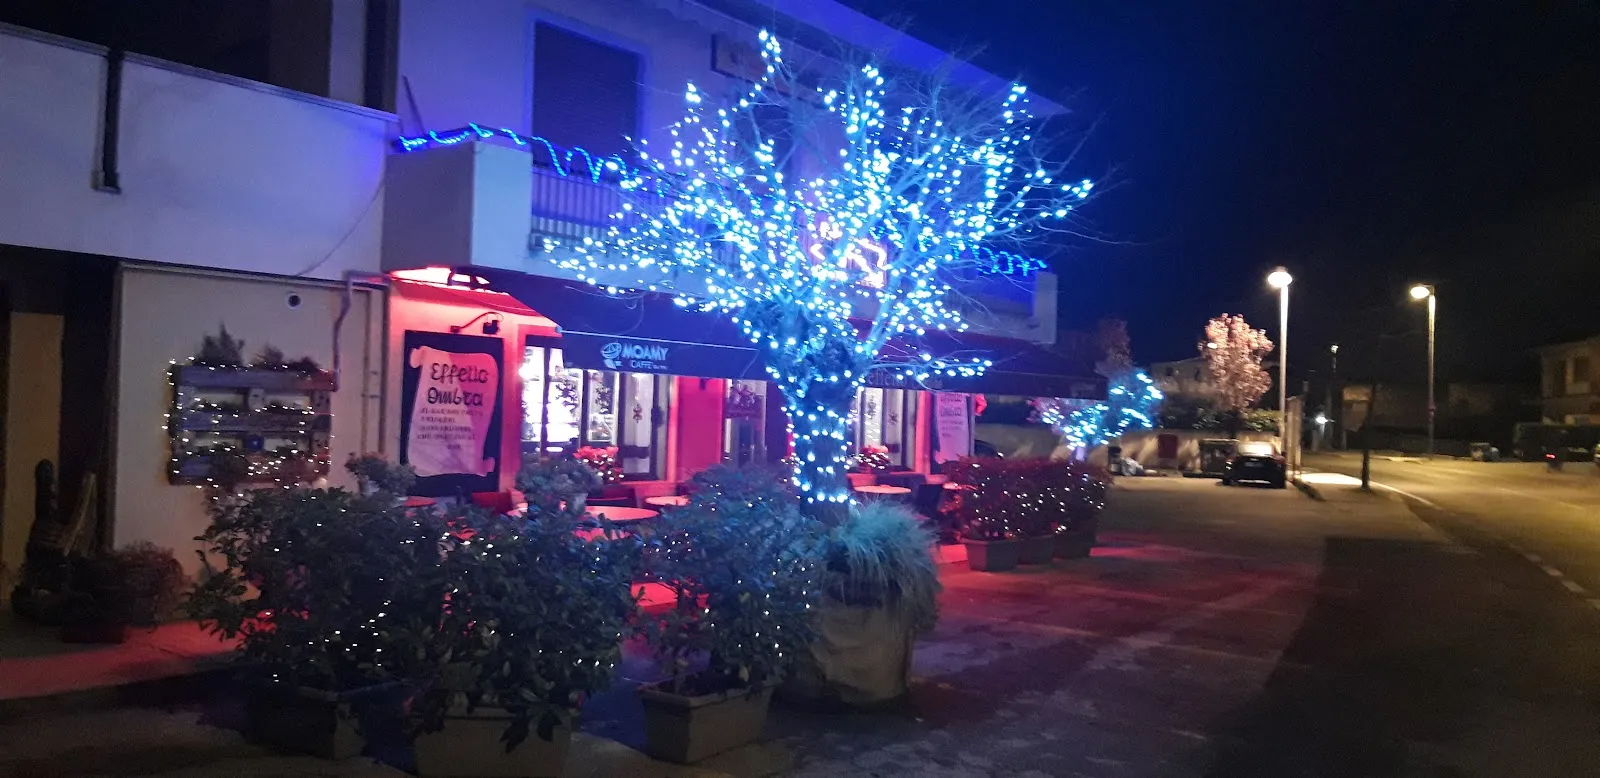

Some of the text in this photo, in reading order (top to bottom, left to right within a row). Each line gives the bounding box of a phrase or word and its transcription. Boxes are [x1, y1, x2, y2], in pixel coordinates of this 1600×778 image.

[622, 343, 668, 361] MOAMY
[431, 362, 489, 384] Effetto
[427, 386, 484, 407] Ombra
